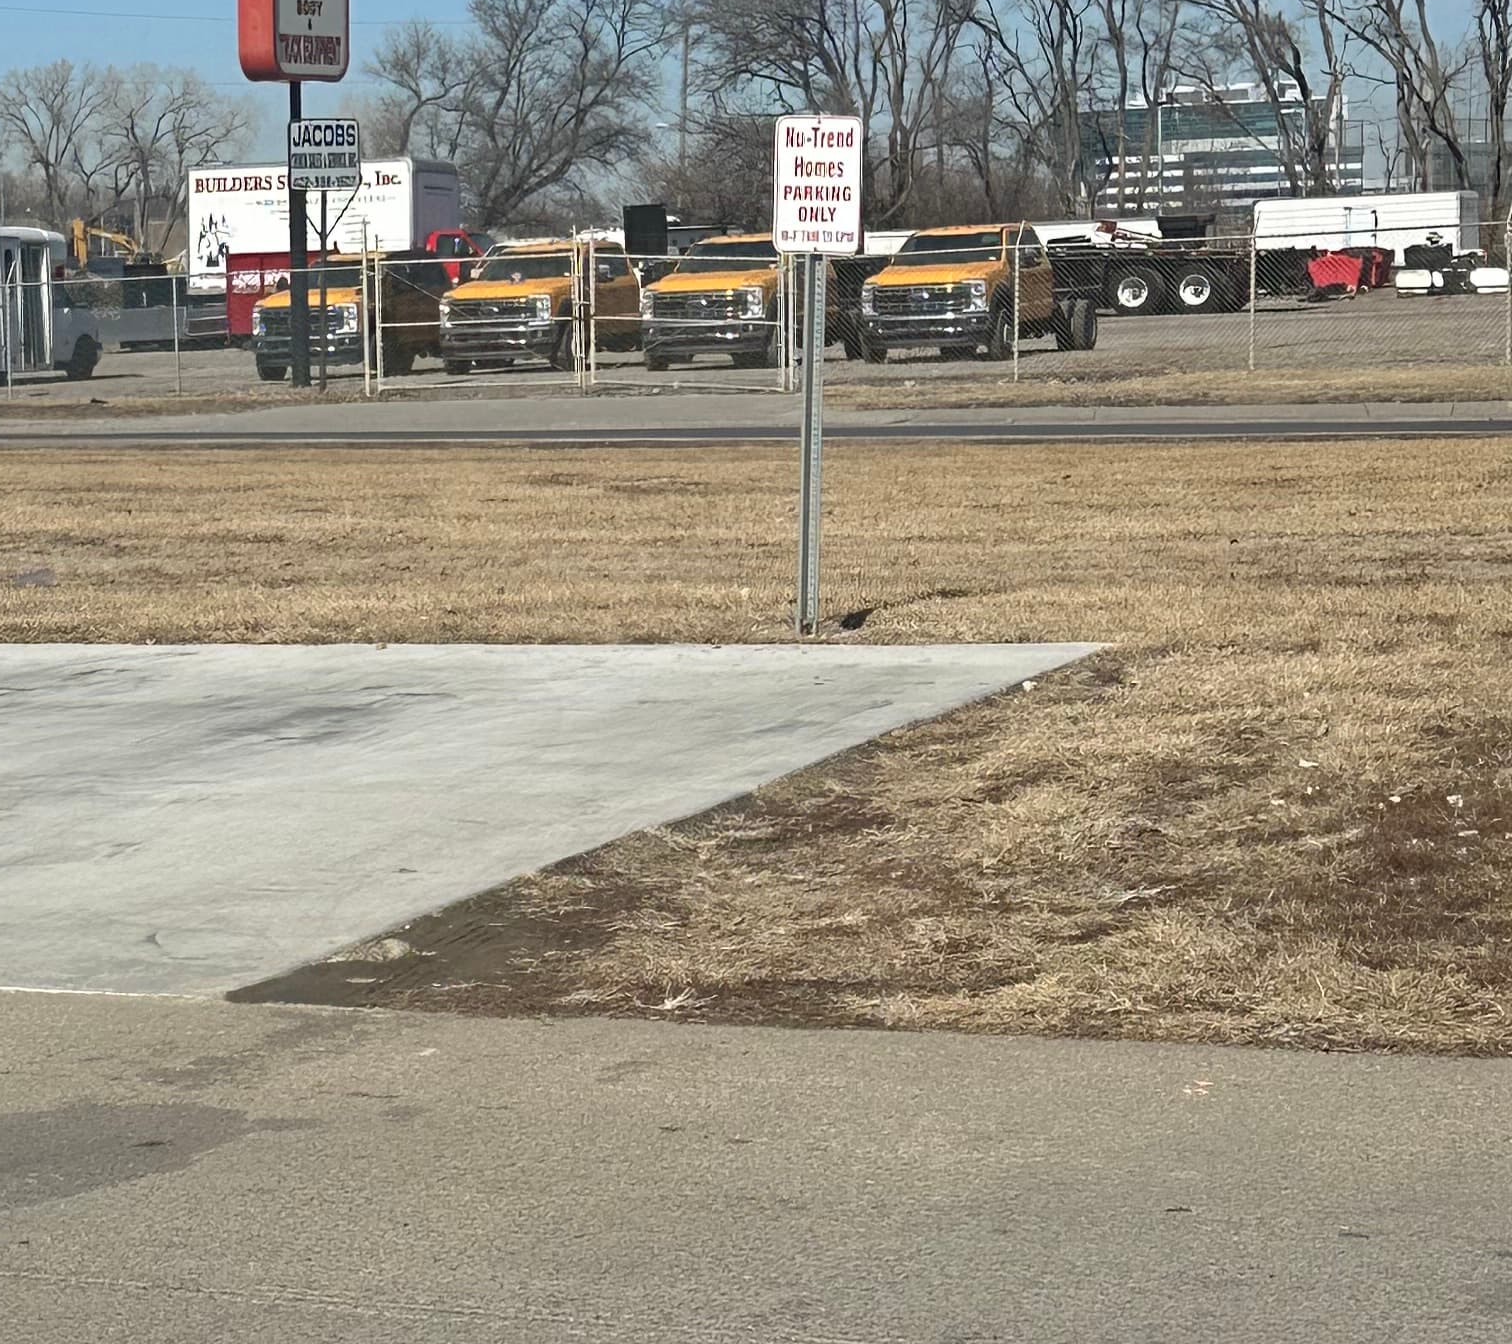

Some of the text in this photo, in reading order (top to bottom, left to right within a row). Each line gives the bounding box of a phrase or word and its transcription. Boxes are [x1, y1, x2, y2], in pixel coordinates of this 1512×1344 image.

[292, 125, 356, 147] JACOBS
[785, 126, 854, 148] Nu-Trend
[794, 155, 845, 177] Homes
[193, 175, 273, 194] BUILDERS
[783, 185, 852, 202] PARKING
[798, 206, 837, 223] ONLY
